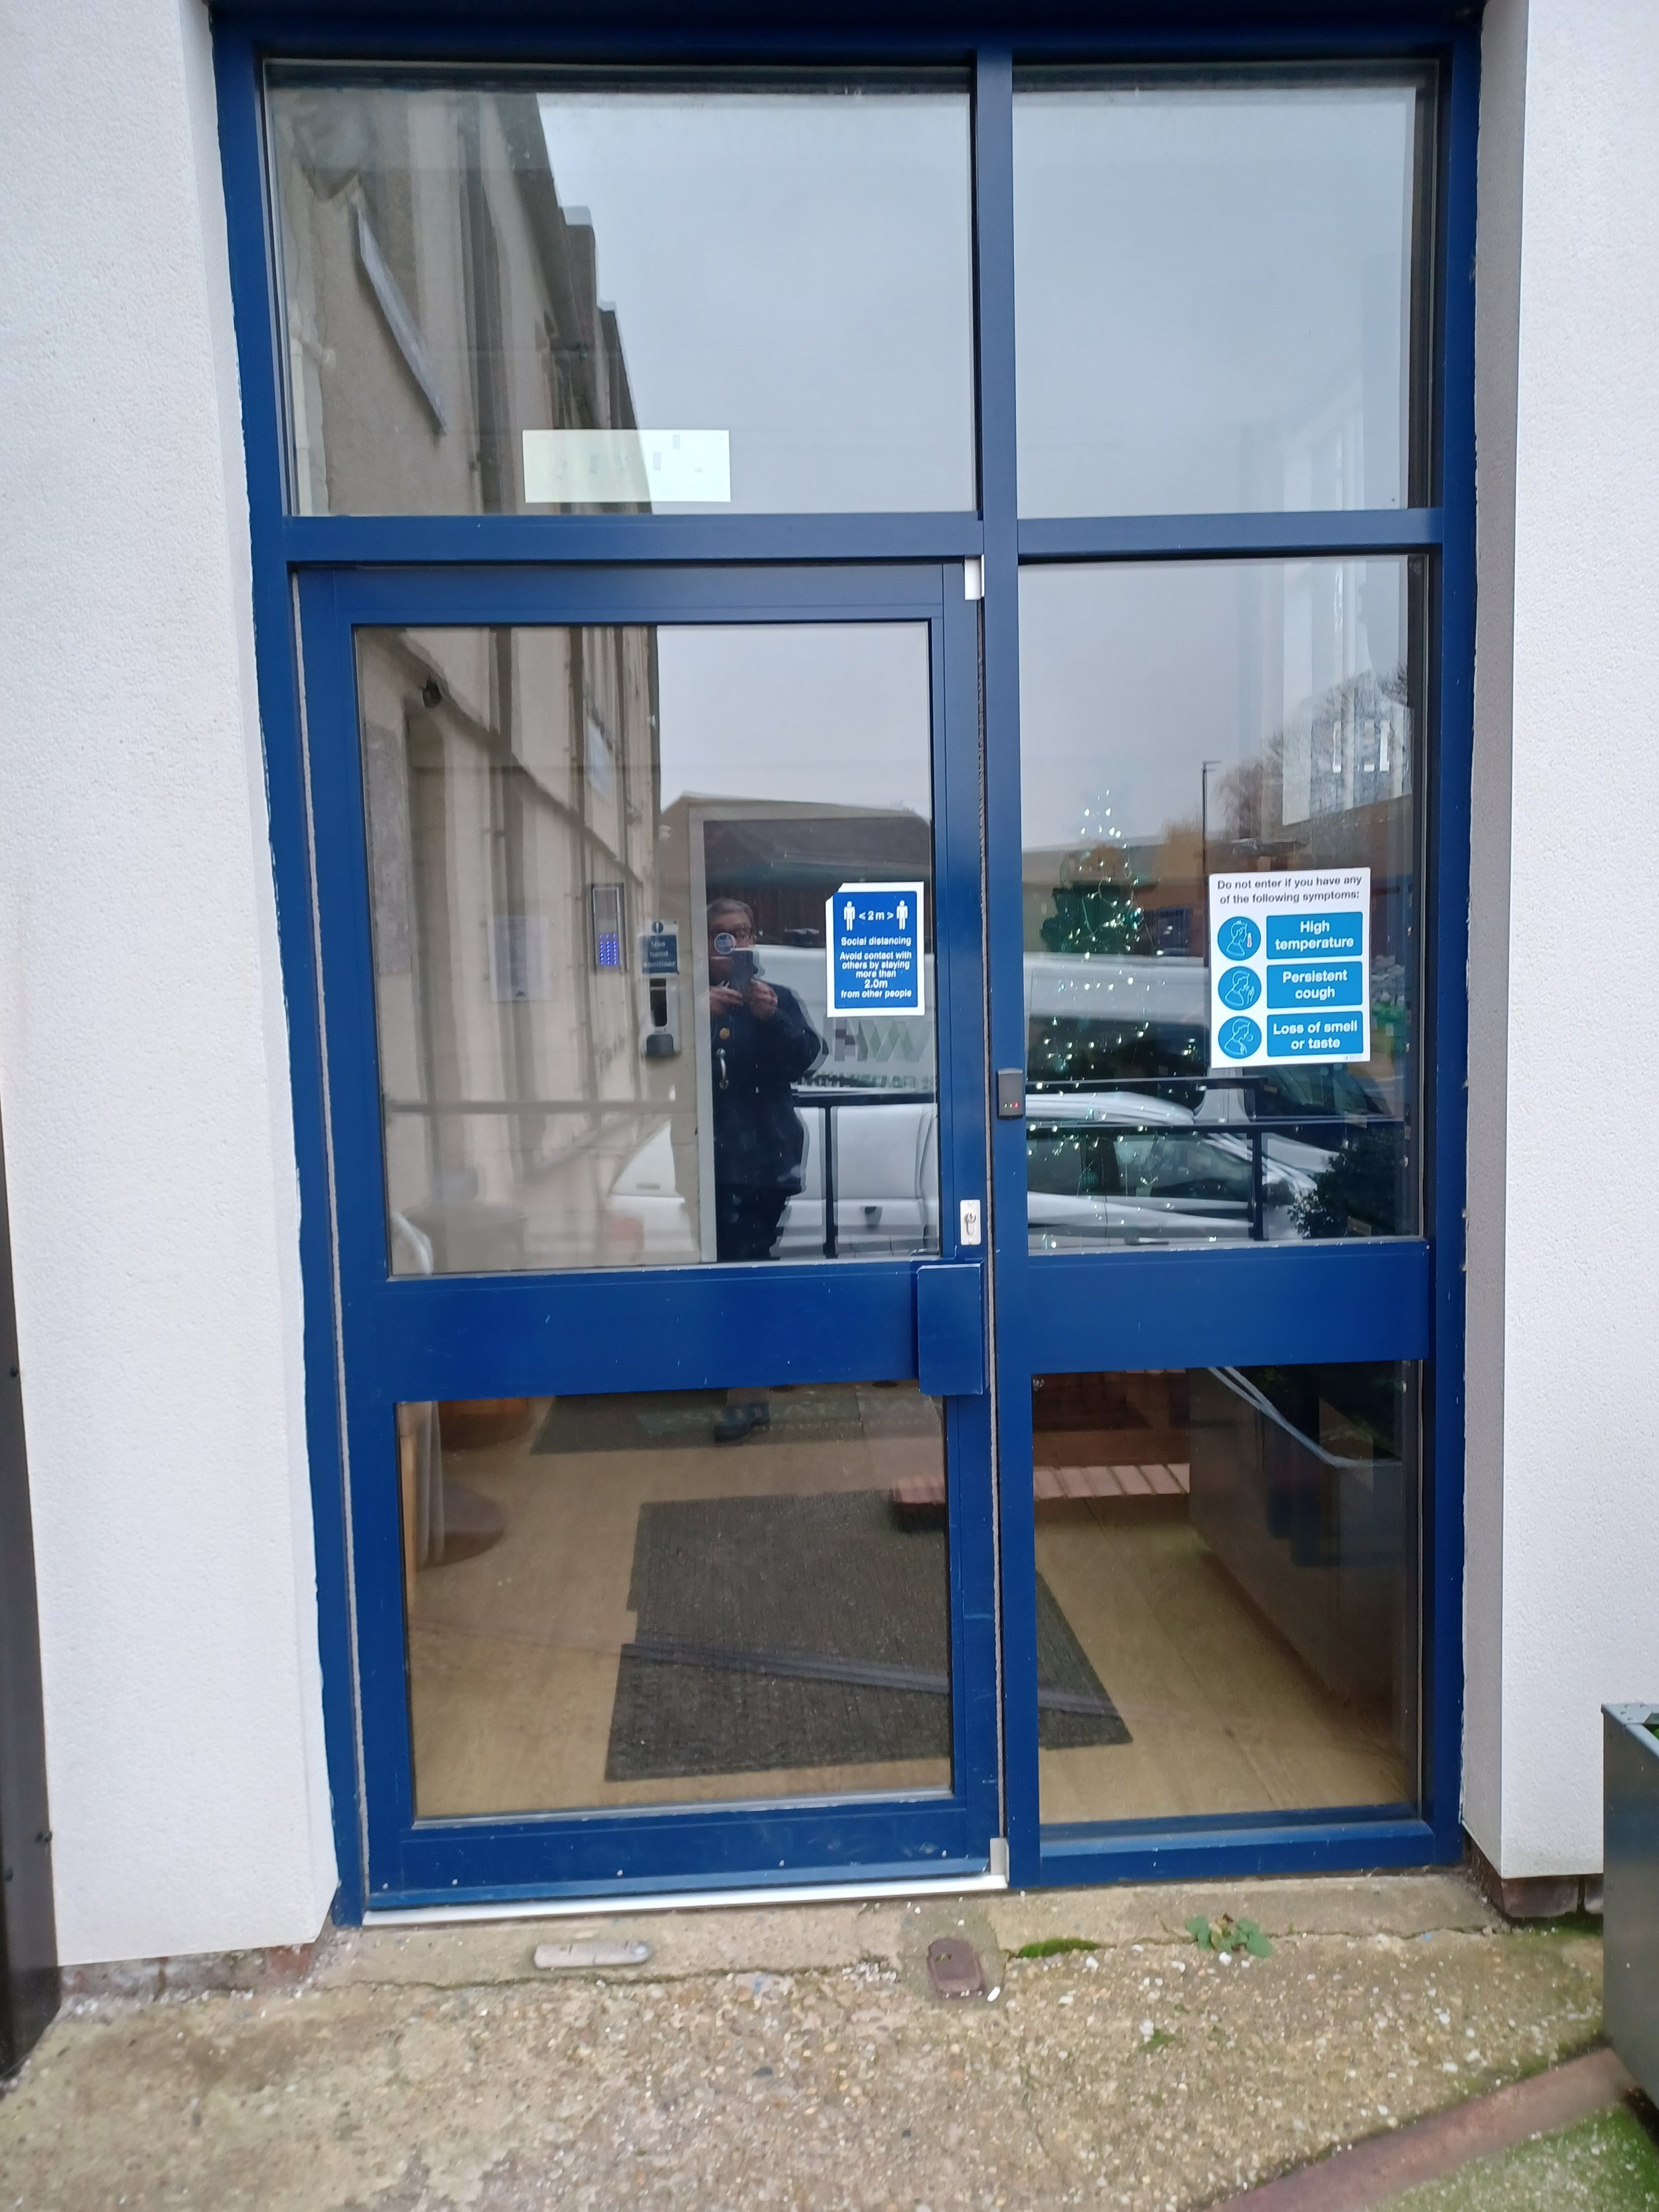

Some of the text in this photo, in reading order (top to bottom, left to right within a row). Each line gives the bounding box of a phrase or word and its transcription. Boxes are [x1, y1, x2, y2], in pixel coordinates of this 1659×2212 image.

[1217, 875, 1362, 890] Do not enter if you have any
[1220, 891, 1359, 905] of the following symptoms:
[1301, 921, 1329, 935] High
[841, 936, 911, 946] Social distancing
[1275, 937, 1354, 952] temperature
[839, 950, 911, 960] Avoid contact with
[869, 961, 879, 970] by
[881, 960, 910, 970] staying
[865, 979, 888, 988] 2.0m
[1283, 970, 1348, 984] Persistent
[841, 989, 911, 999] from other people
[1295, 987, 1334, 1001] cough
[1273, 1020, 1358, 1035] Loss of smell
[1291, 1038, 1340, 1050] or taste
